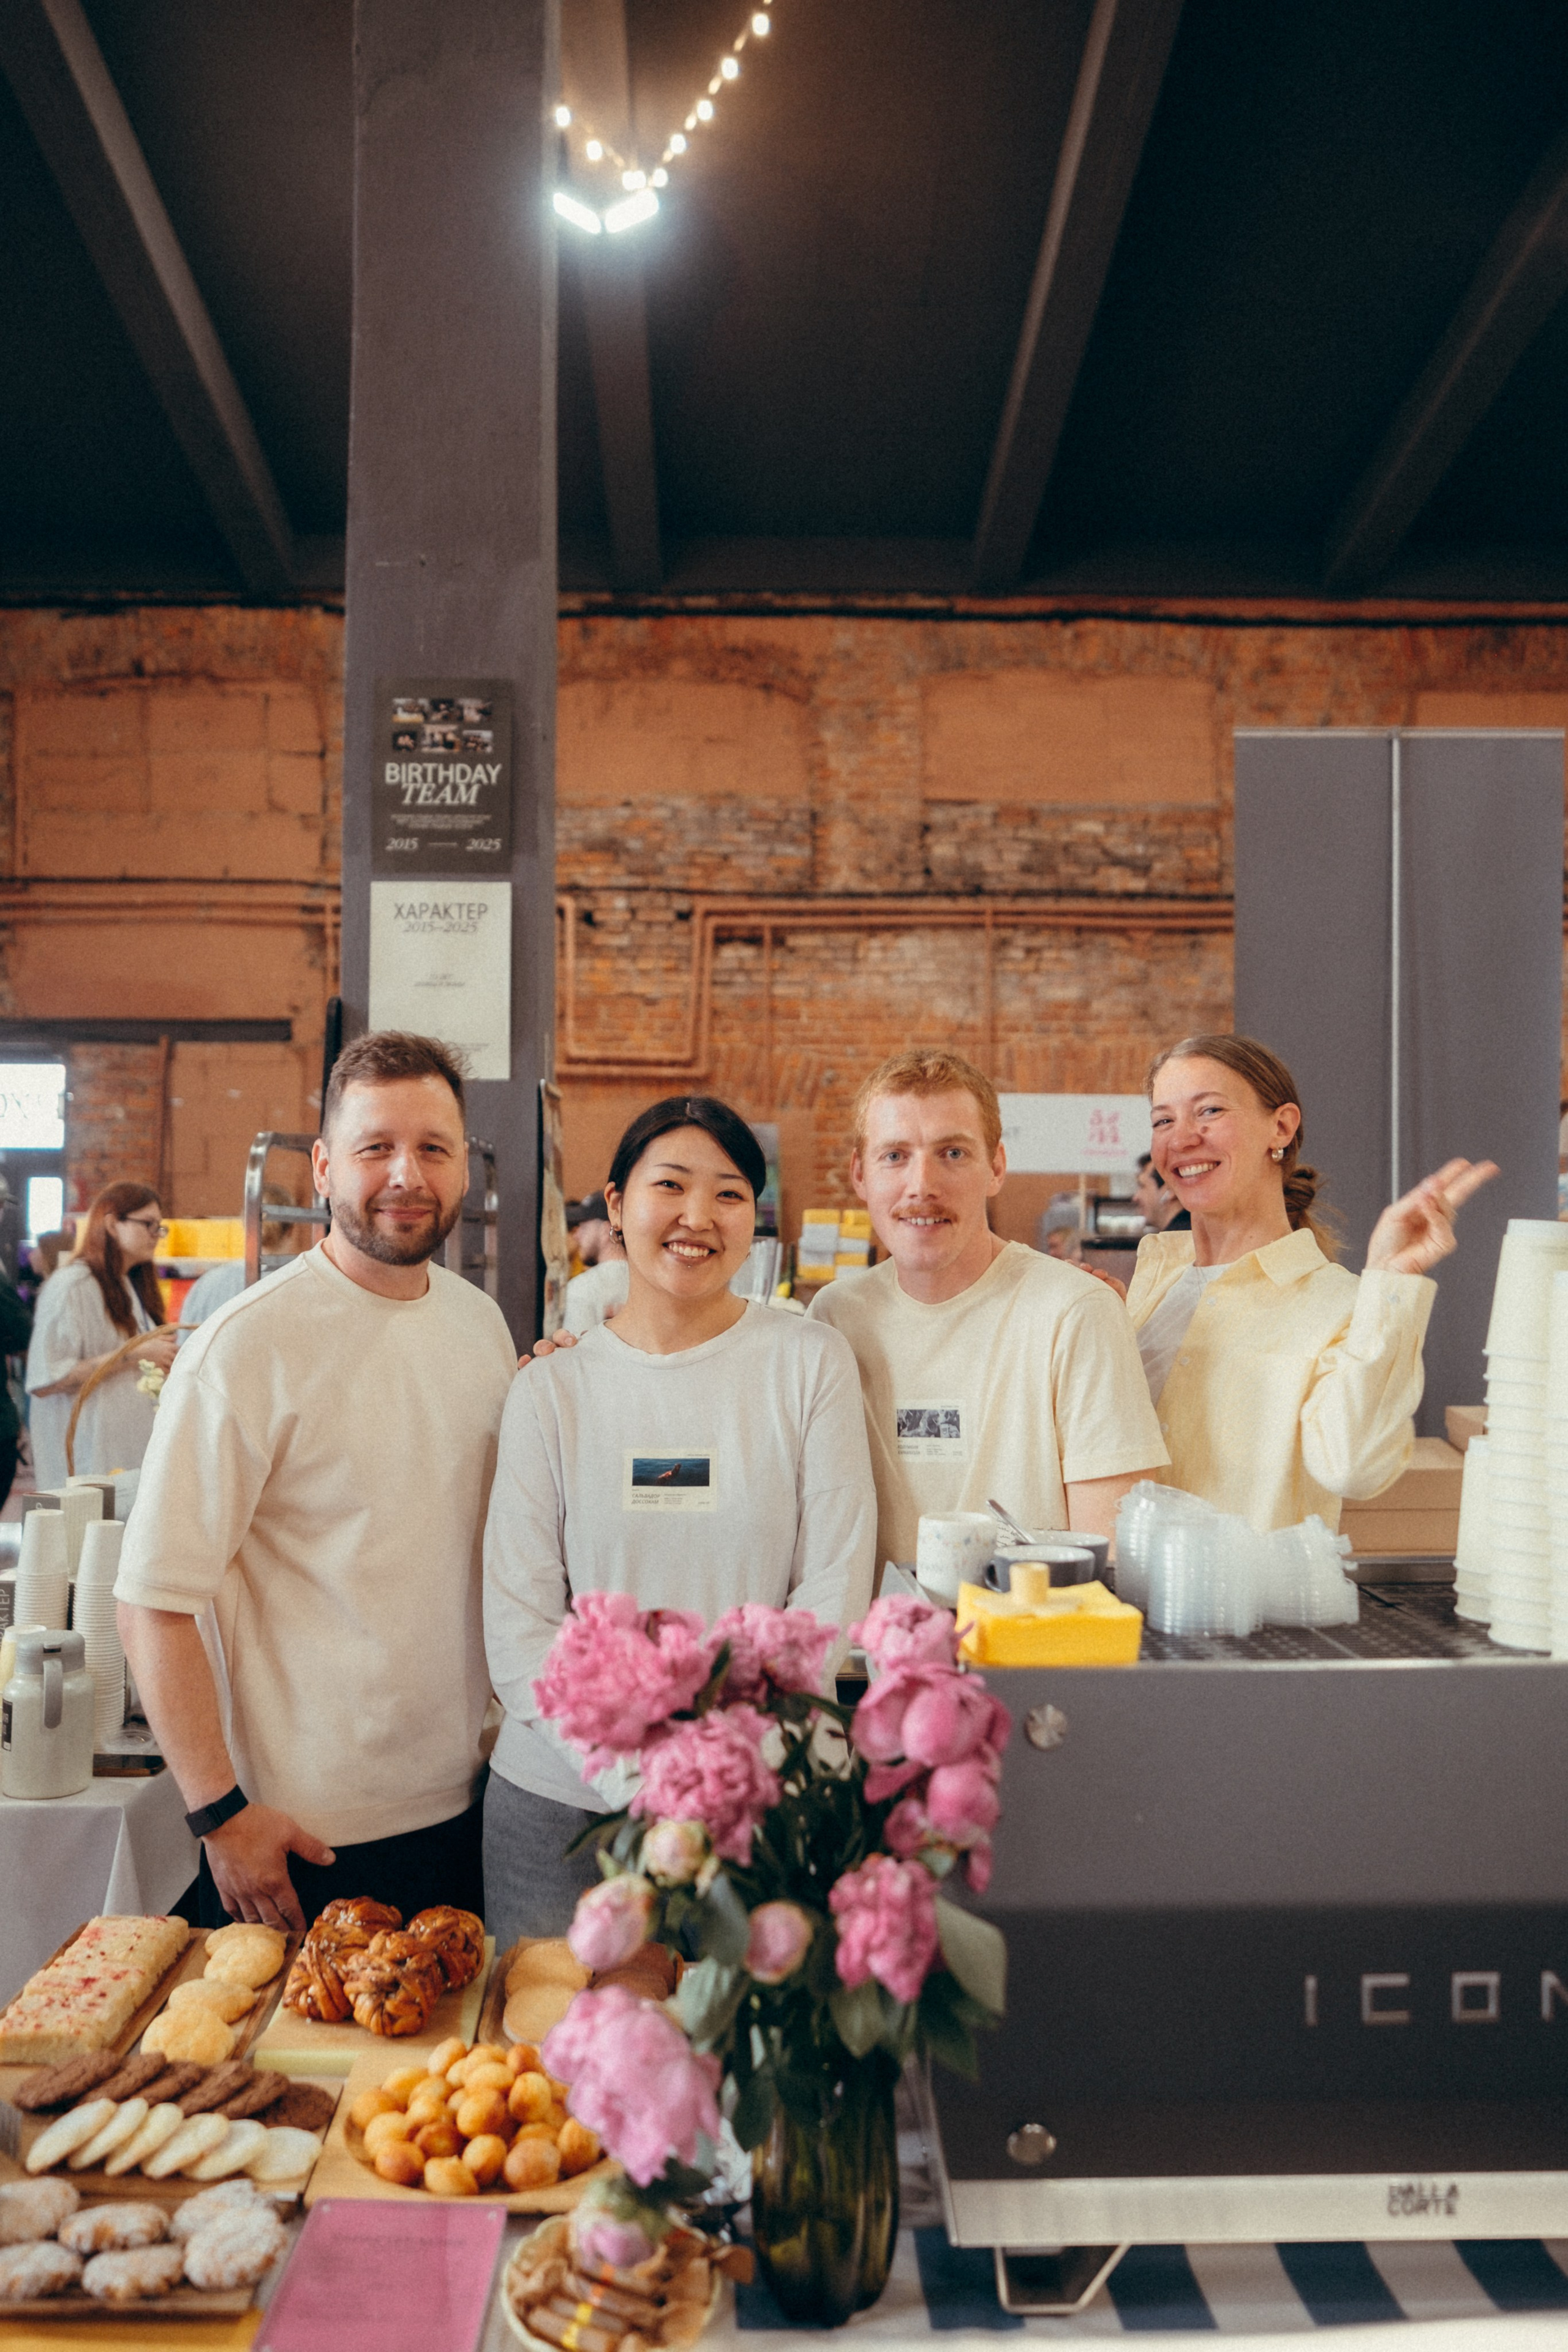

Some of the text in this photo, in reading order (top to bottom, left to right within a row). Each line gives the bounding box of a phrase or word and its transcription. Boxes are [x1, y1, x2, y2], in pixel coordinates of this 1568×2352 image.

[385, 763, 502, 784] BIRTHDAY
[401, 783, 481, 805] TEAM
[385, 837, 502, 852] 2015 2025
[394, 902, 488, 919] ХАРАКТЕР
